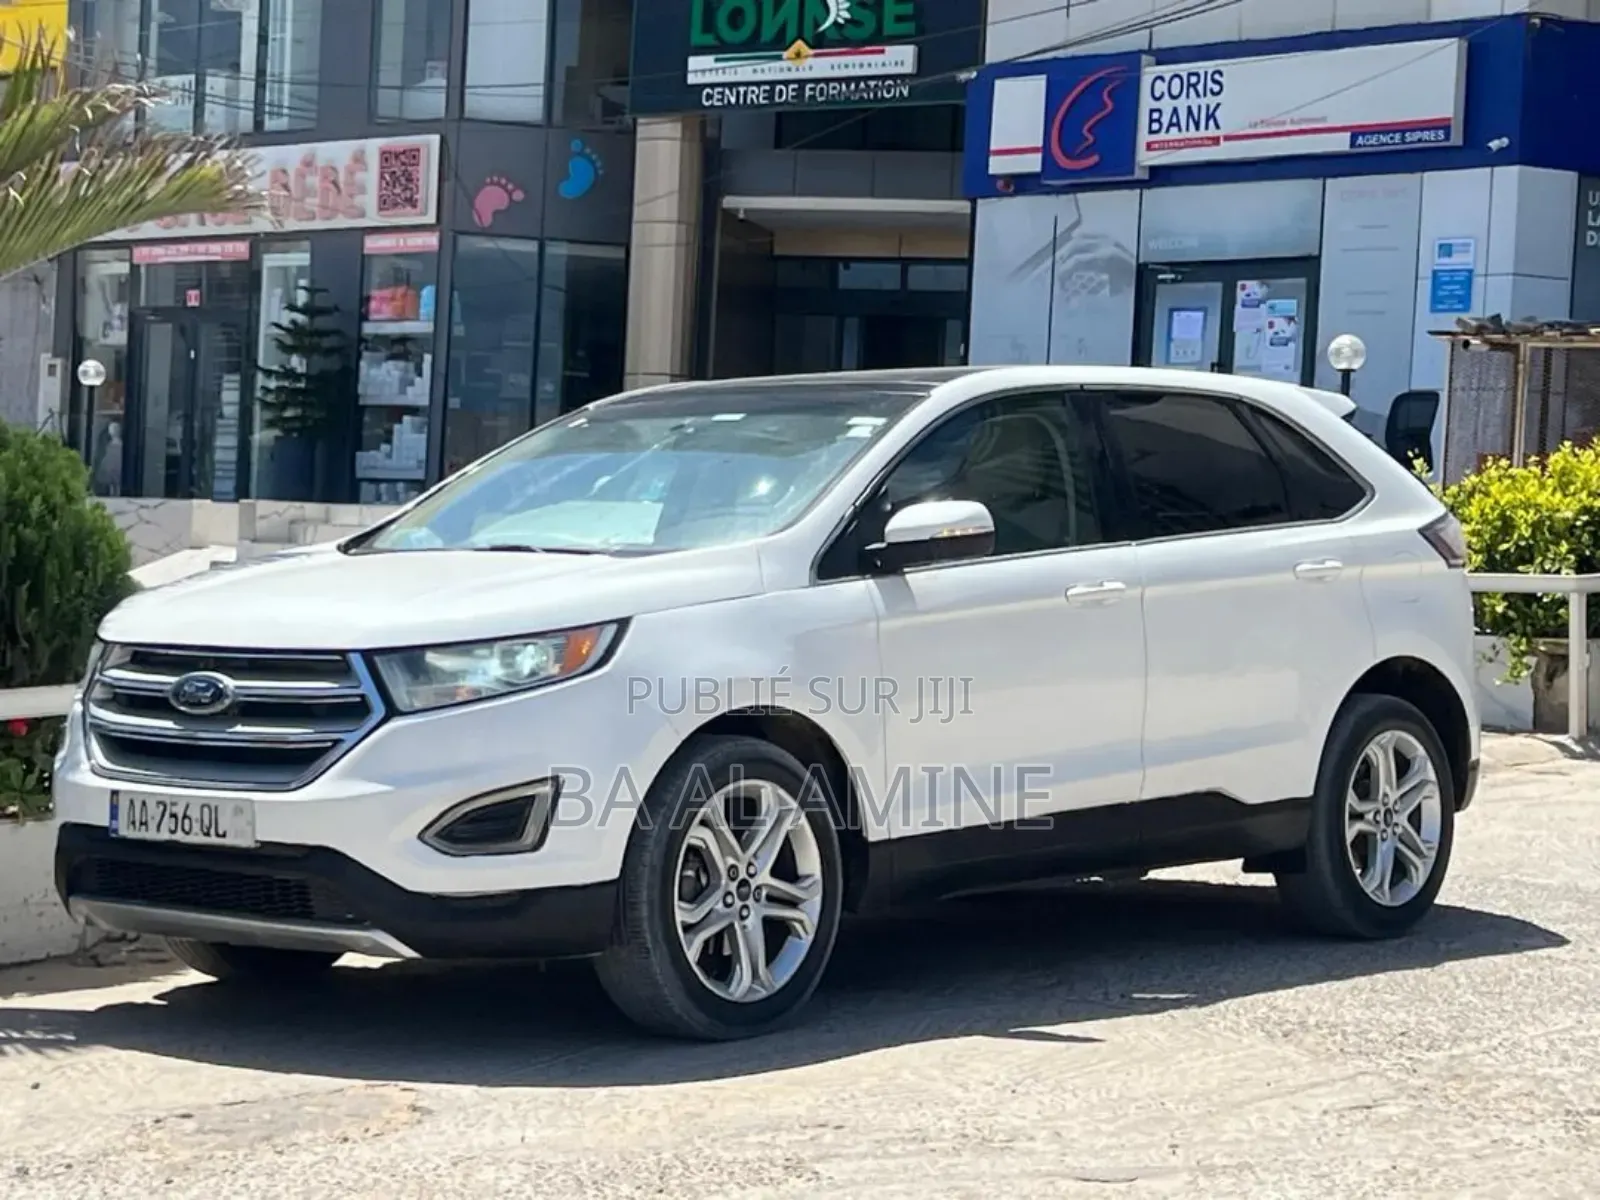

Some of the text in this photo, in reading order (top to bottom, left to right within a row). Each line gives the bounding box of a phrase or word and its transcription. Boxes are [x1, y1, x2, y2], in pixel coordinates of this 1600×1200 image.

[702, 79, 909, 106] CENTRE DE FORMATION
[1150, 69, 1224, 101] CORIS
[1147, 103, 1221, 134] BANK
[1356, 129, 1445, 146] AGENCE SIPRES
